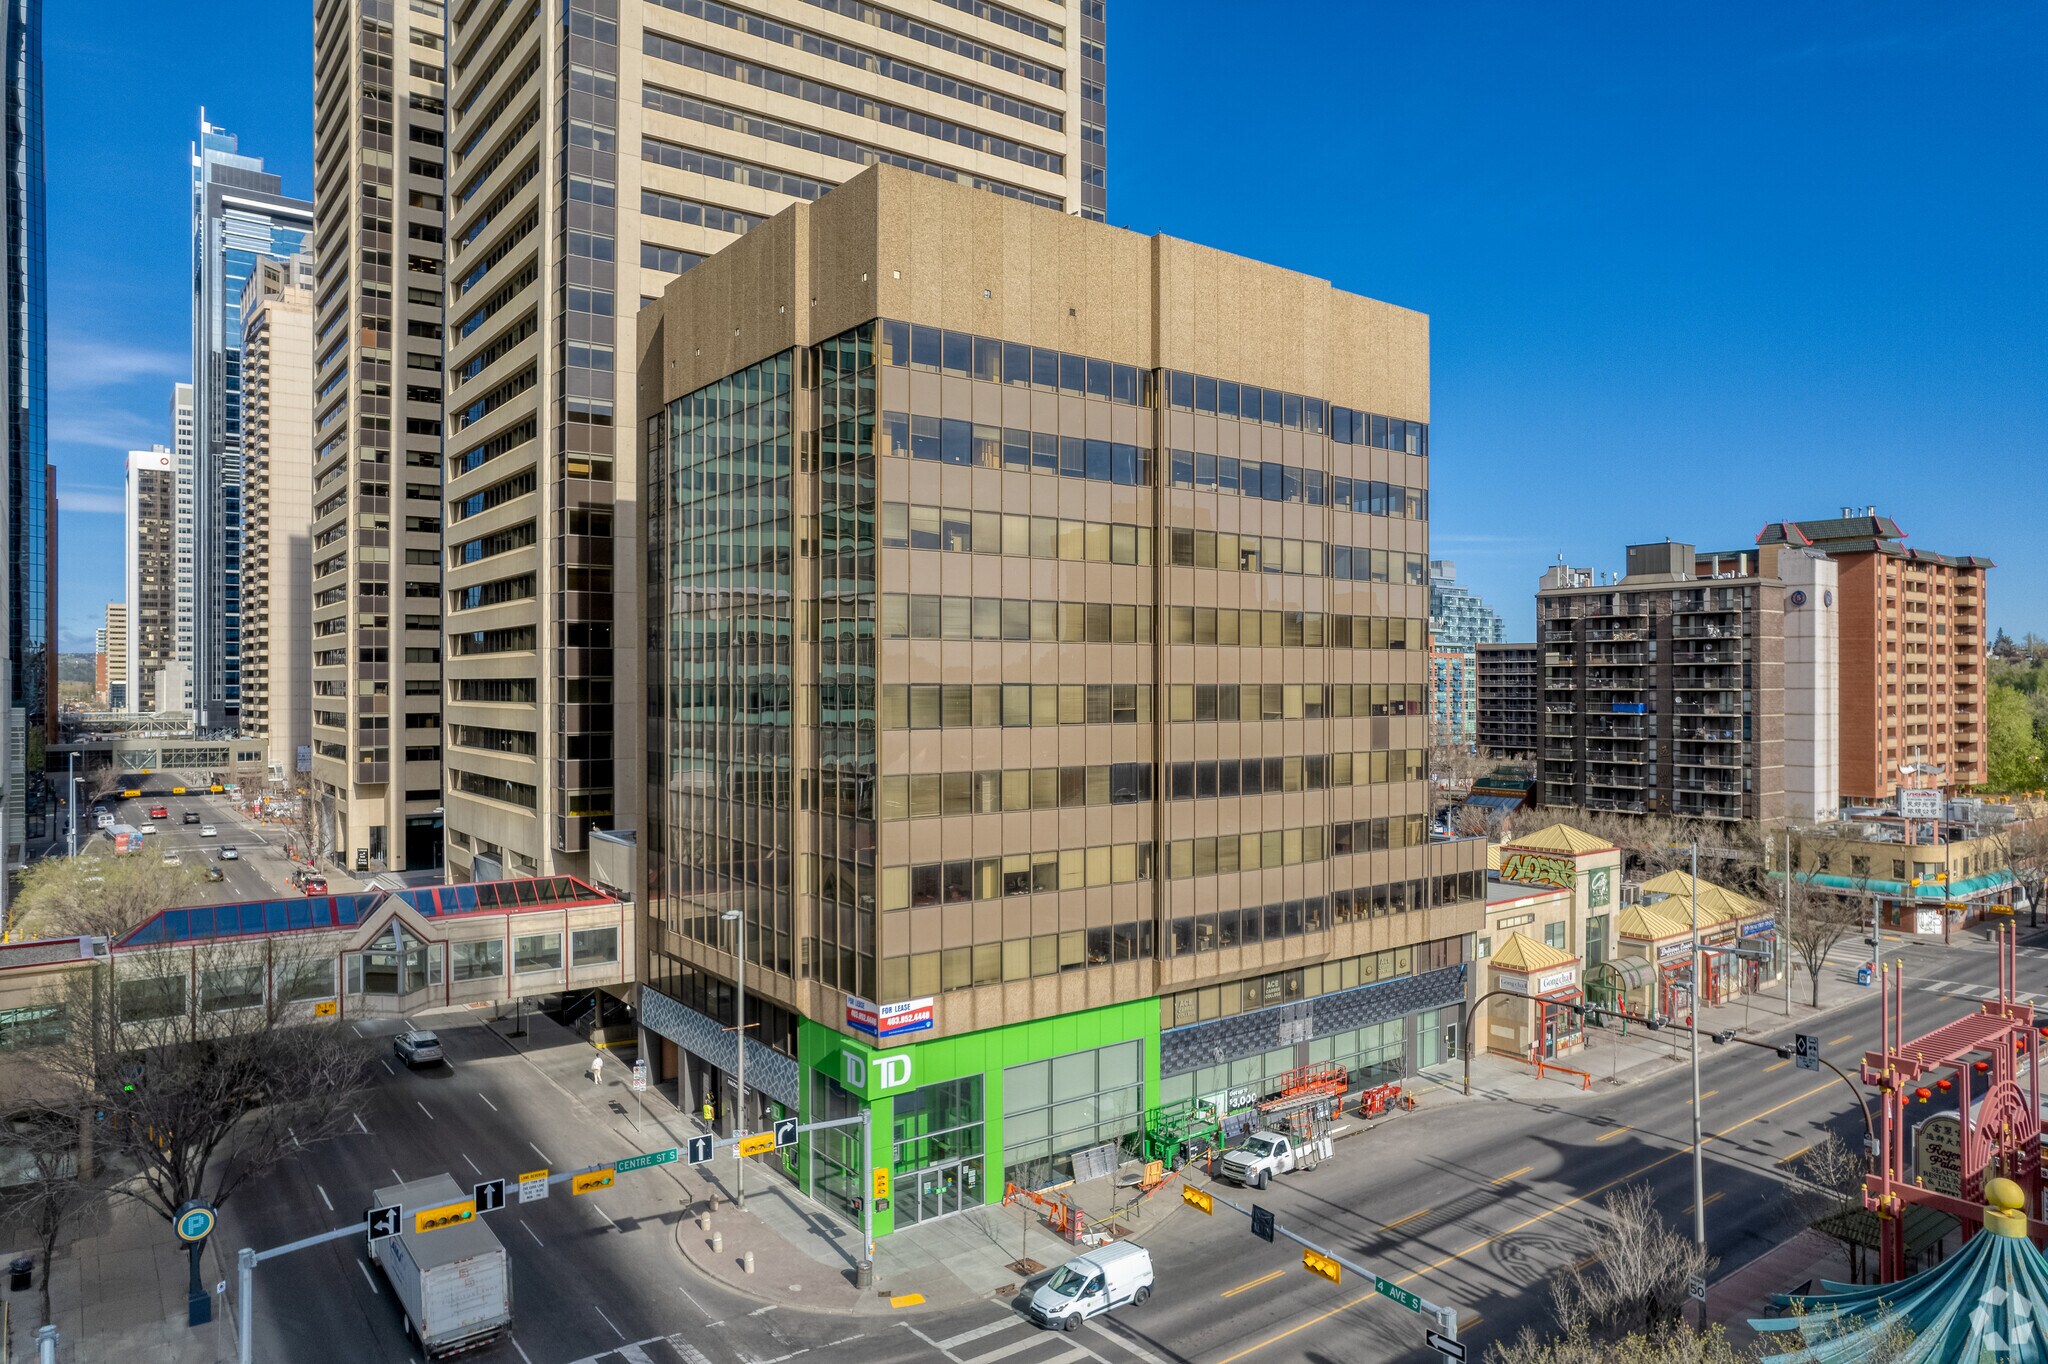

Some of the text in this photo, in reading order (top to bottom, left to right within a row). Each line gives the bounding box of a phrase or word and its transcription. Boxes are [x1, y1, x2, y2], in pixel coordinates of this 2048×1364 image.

[1267, 980, 1279, 988] ACE
[1544, 976, 1559, 987] Gong
[1559, 974, 1569, 983] cha
[881, 1003, 911, 1015] FOR LEASE
[842, 1050, 866, 1089] TD
[872, 1054, 912, 1090] TD
[1229, 1093, 1258, 1109] $3,000
[618, 1151, 676, 1171] CENTRE ST S
[188, 1215, 204, 1235] P
[1377, 1282, 1419, 1309] 4 AVE S
[1690, 1282, 1705, 1298] 50
